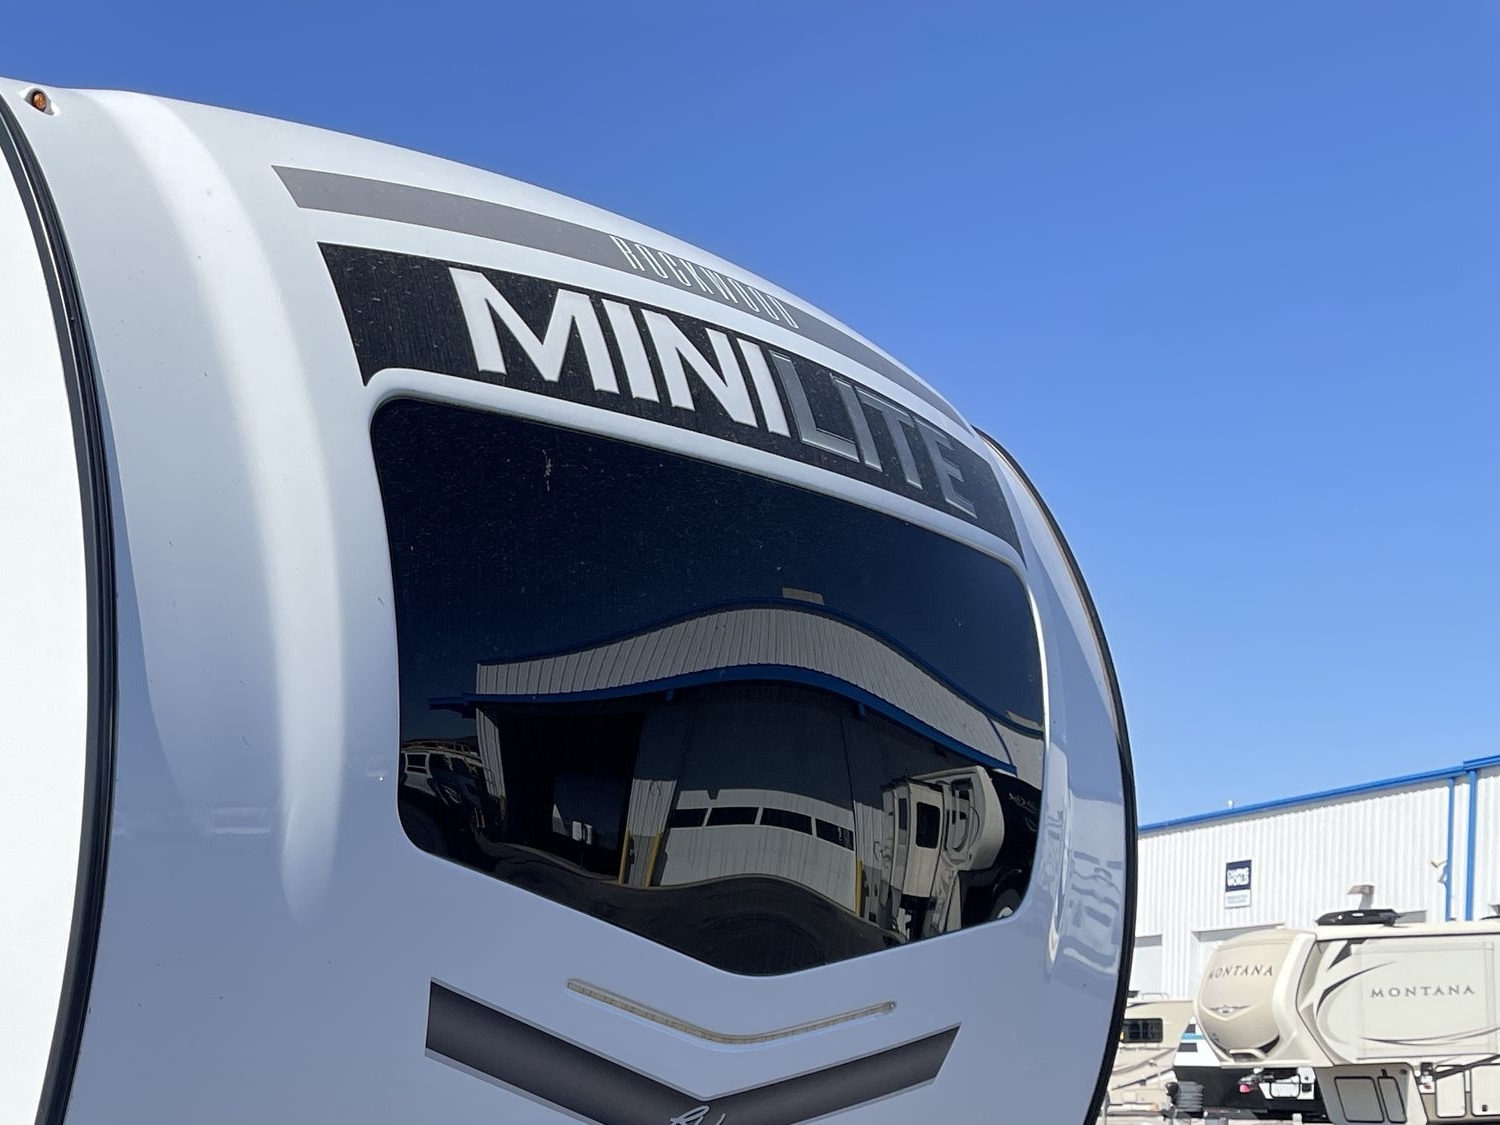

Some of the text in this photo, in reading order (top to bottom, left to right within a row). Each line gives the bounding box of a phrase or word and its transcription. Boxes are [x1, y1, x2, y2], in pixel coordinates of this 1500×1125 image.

[609, 234, 800, 329] ROCKWOOD
[1208, 964, 1274, 980] MONTANA
[1371, 984, 1475, 998] MONTANA
